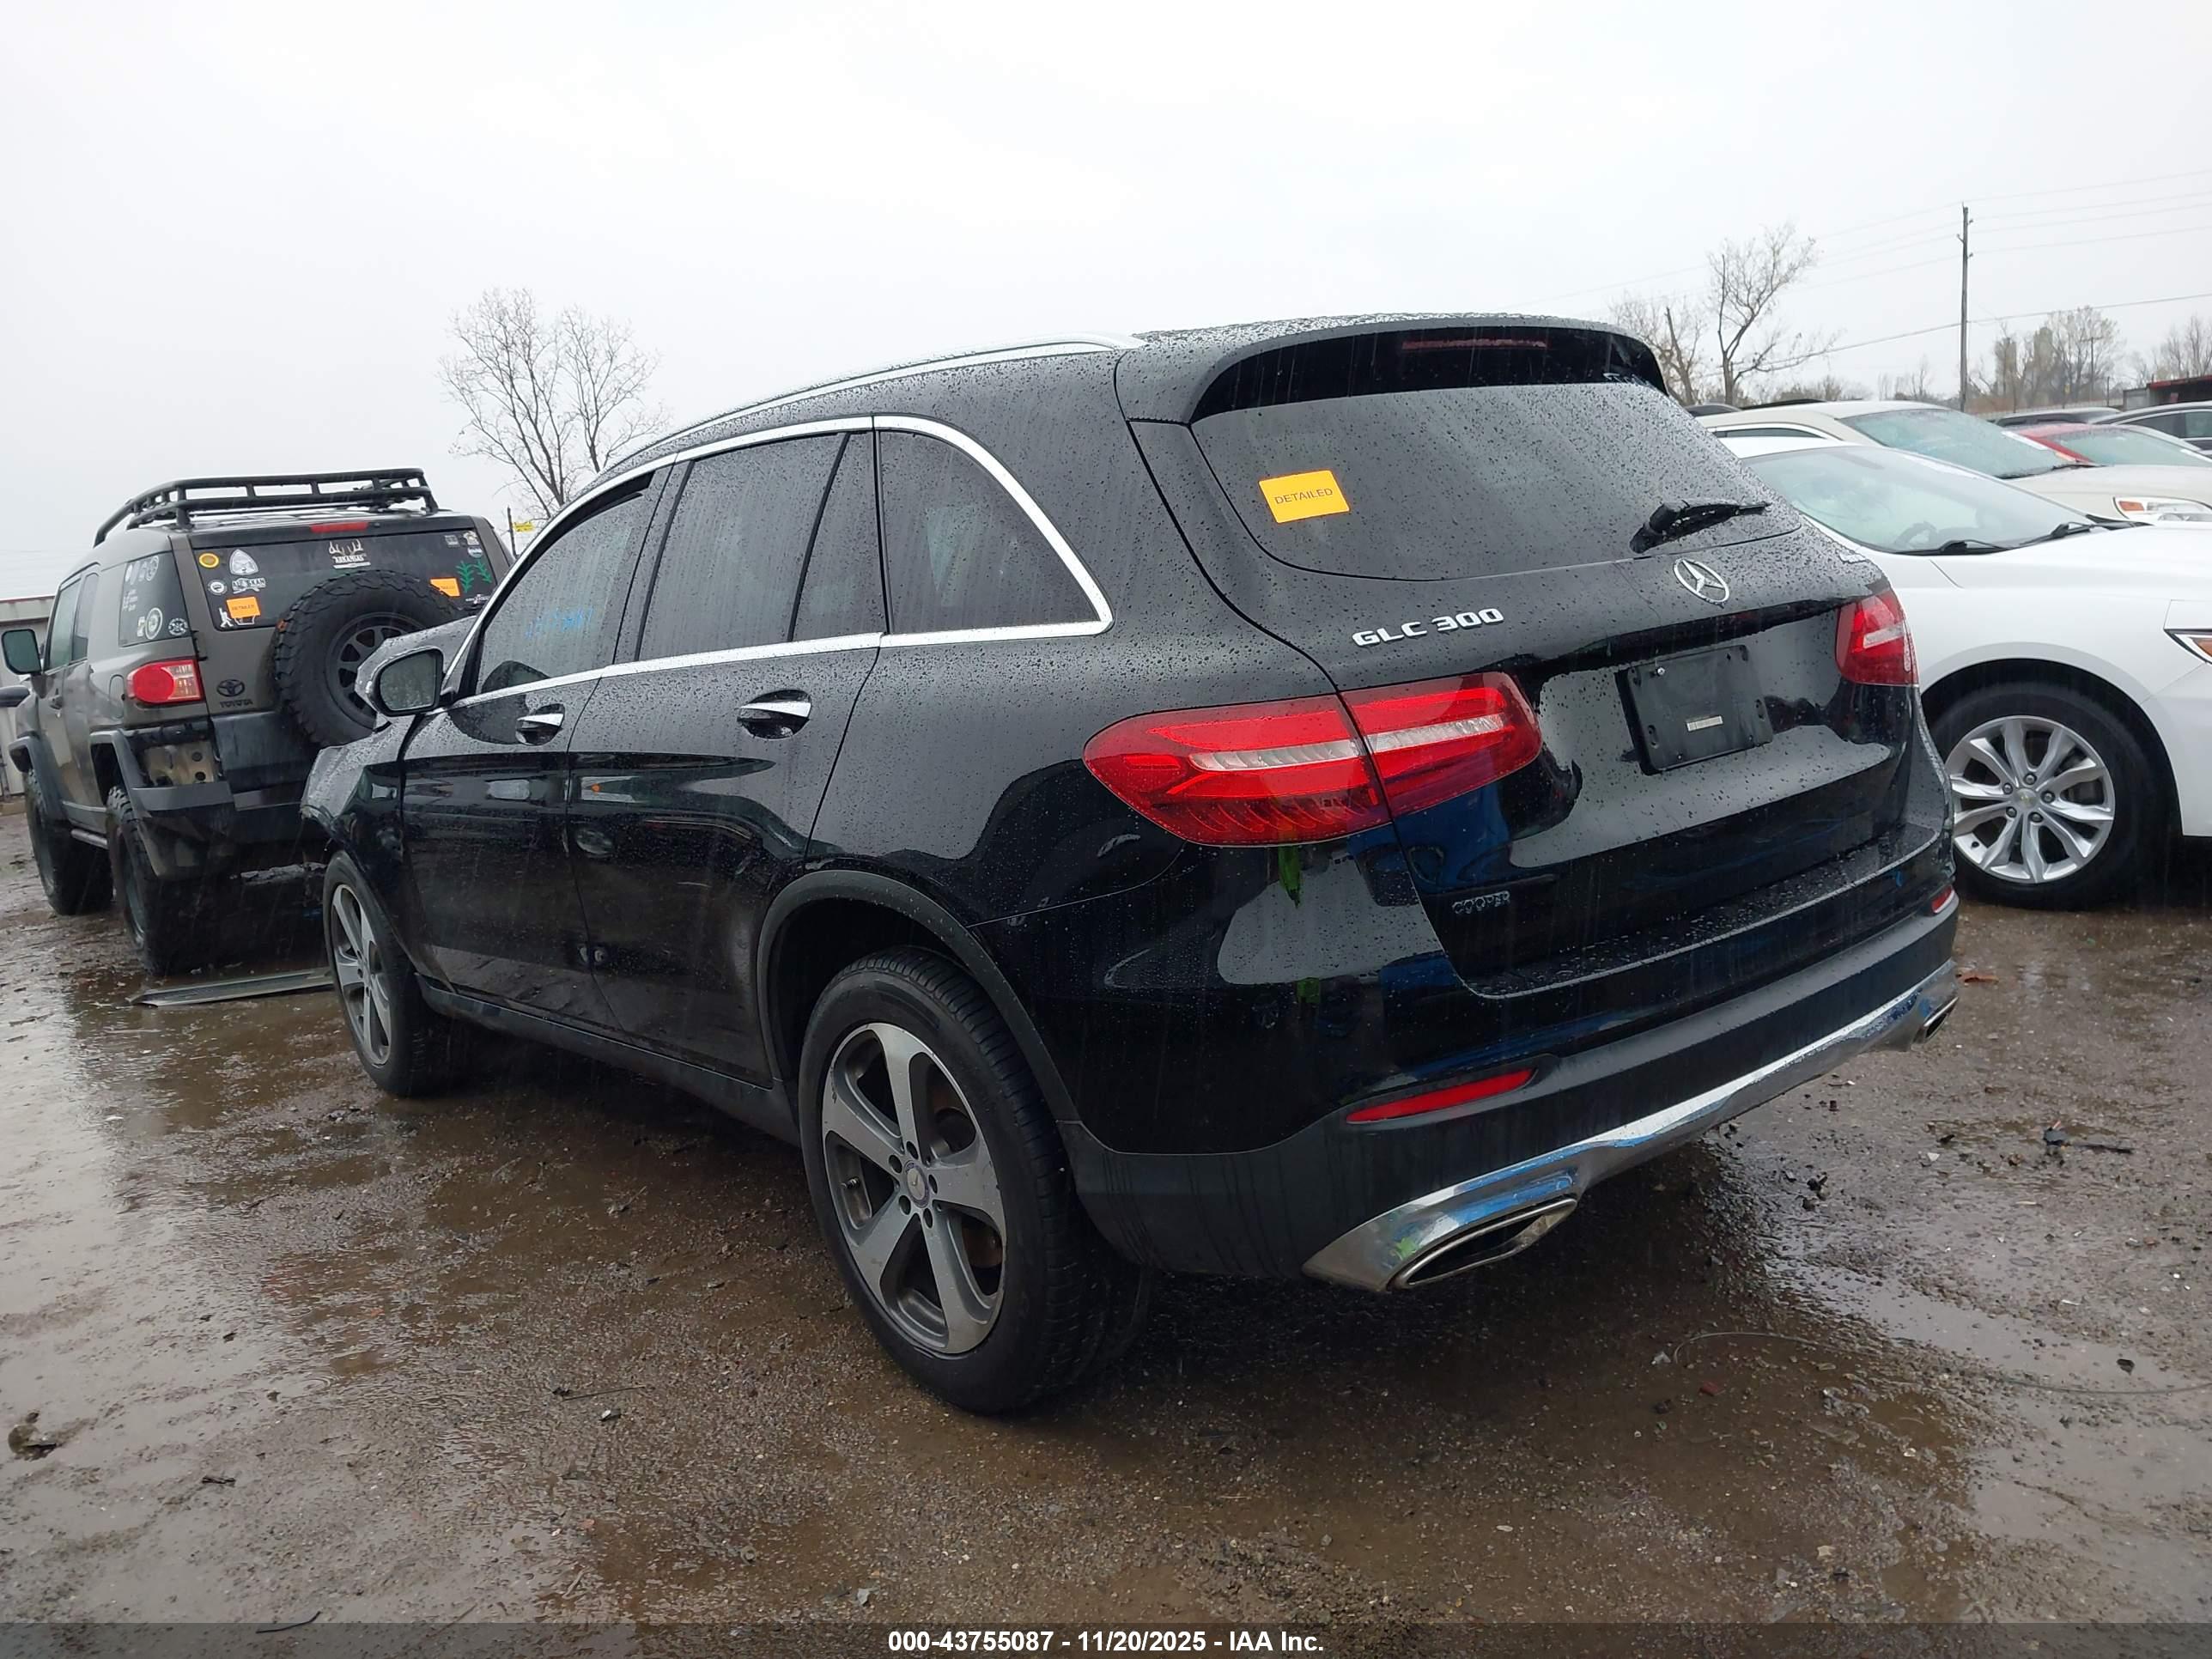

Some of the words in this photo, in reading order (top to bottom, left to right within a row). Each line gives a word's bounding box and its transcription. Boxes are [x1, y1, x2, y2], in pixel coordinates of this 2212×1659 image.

[1274, 487, 1334, 505] DETAILED
[1352, 621, 1428, 647] GLC
[1431, 608, 1504, 632] 300
[219, 698, 254, 708] TOYOTA
[1451, 890, 1510, 915] COOPER
